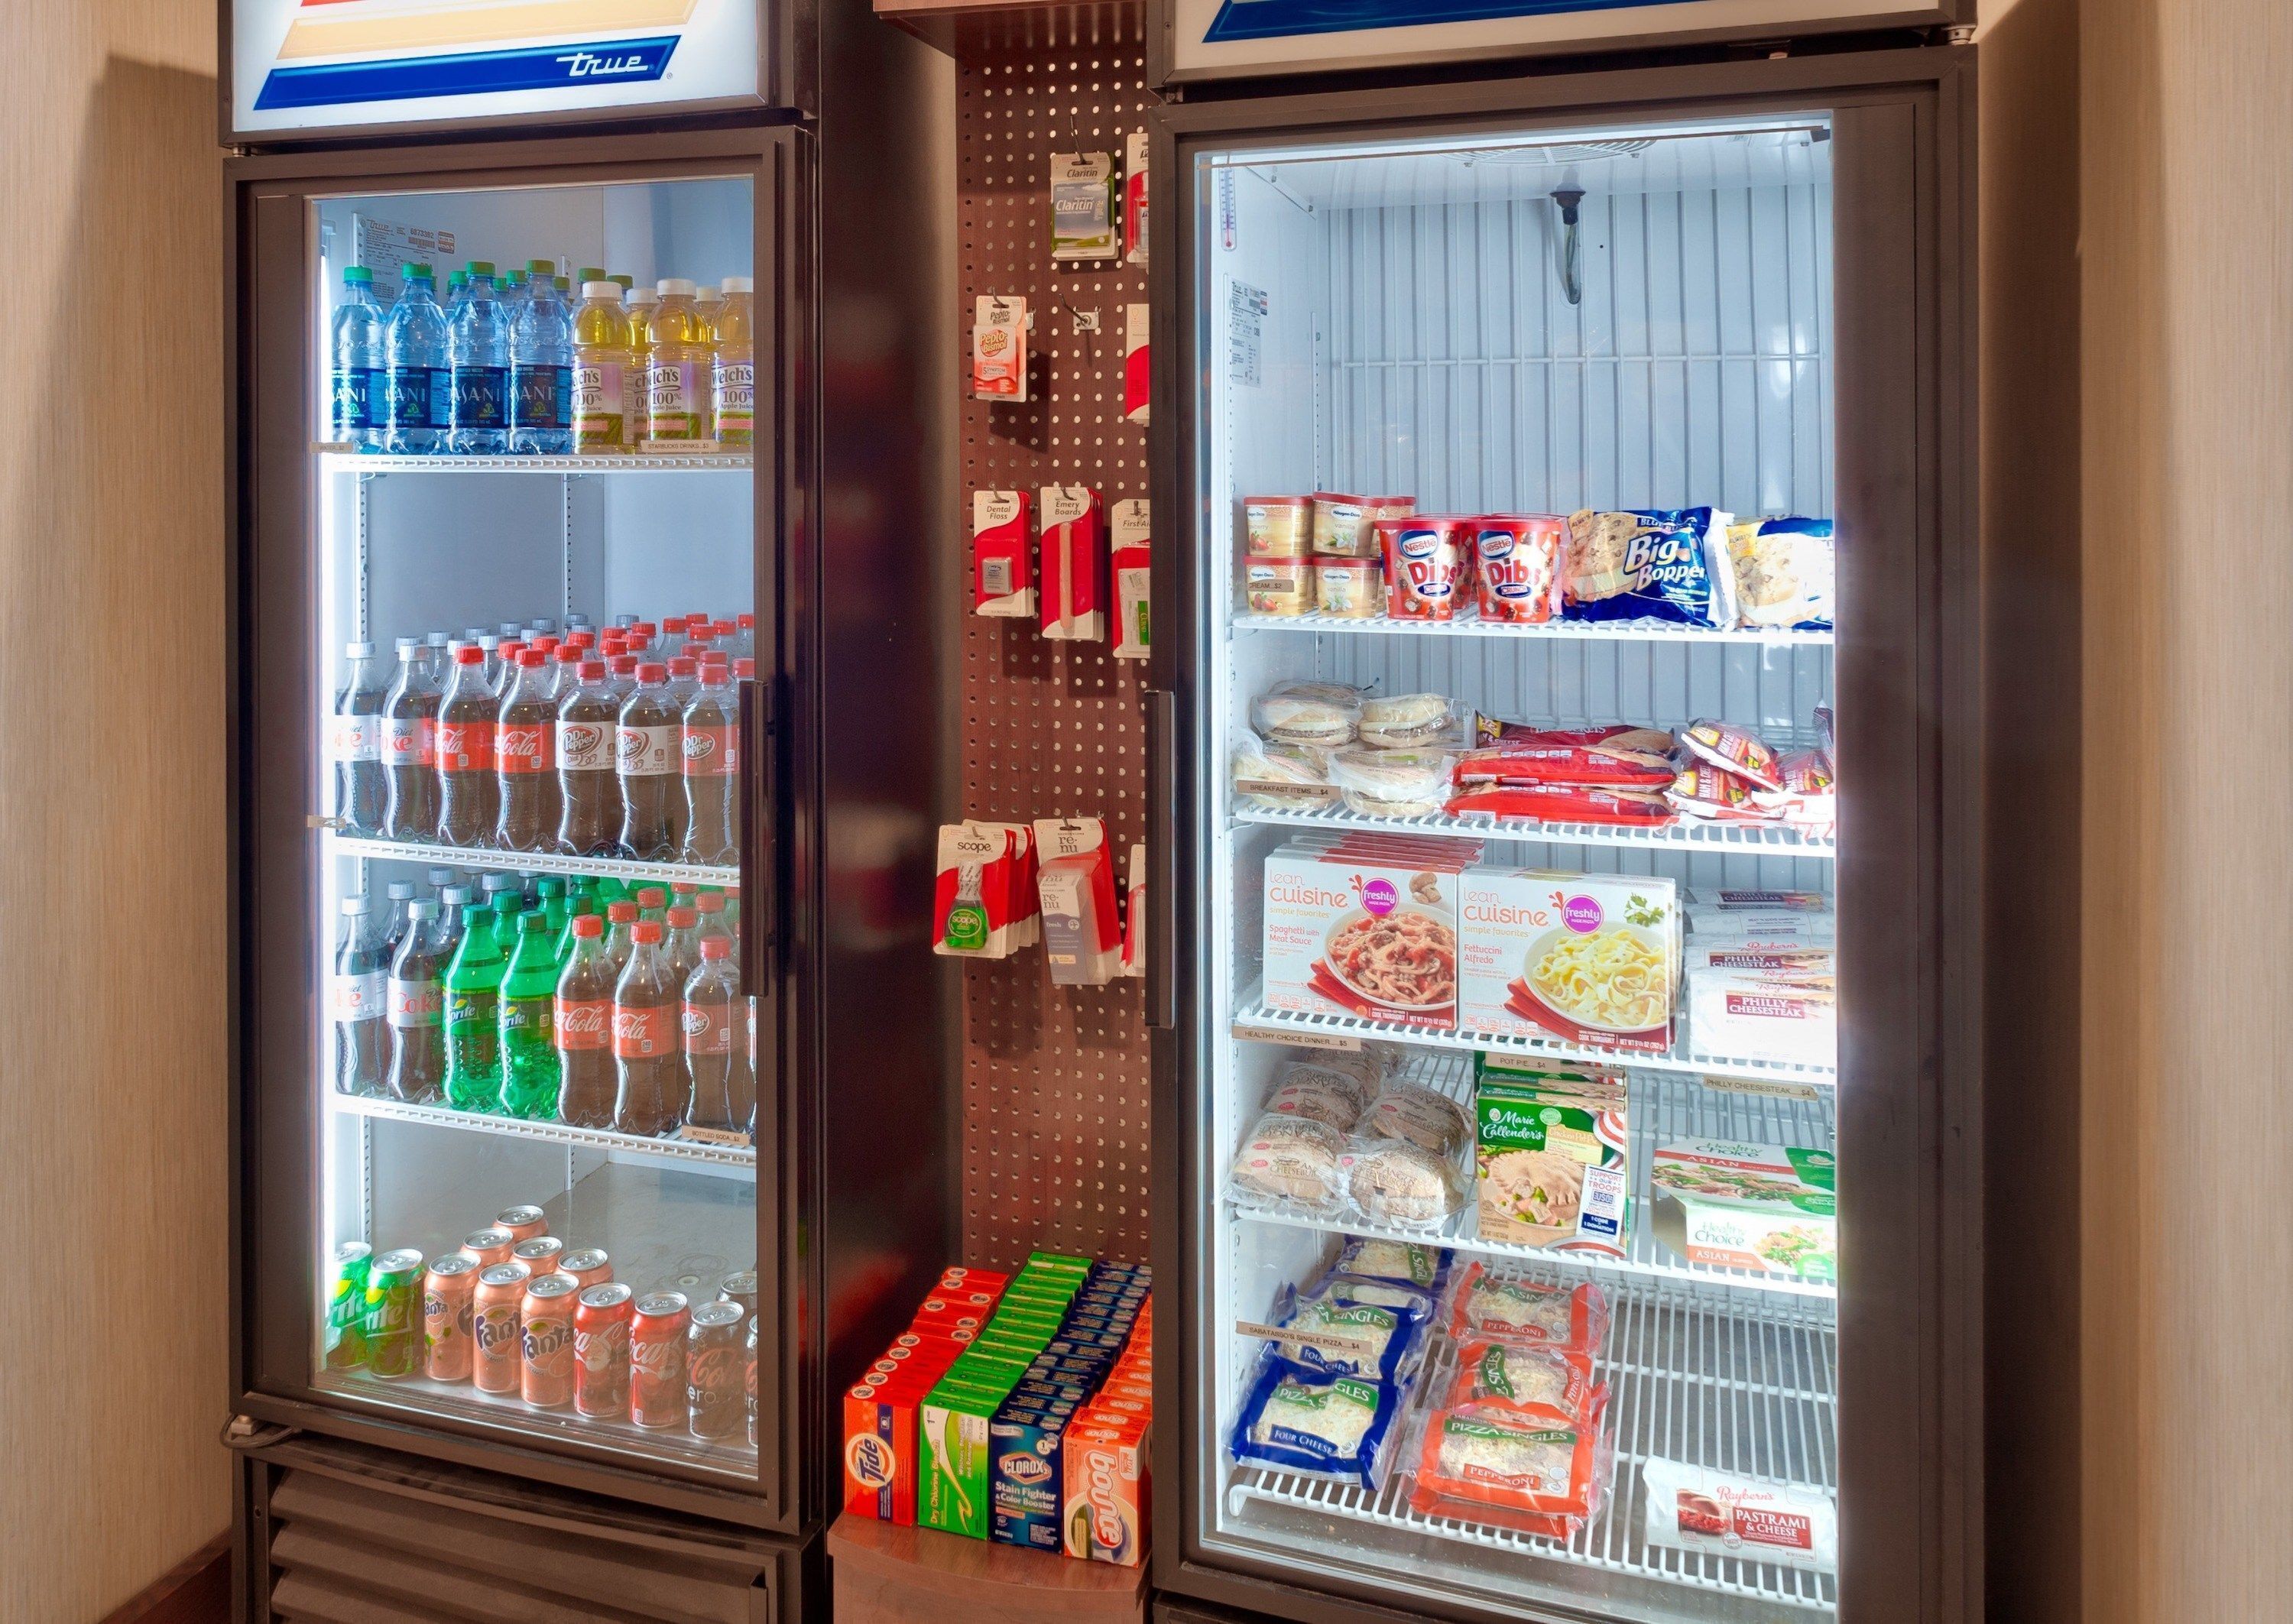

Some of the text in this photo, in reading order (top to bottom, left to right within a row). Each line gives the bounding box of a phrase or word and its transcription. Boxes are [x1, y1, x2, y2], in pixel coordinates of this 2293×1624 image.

[556, 51, 648, 76] true
[1066, 168, 1098, 179] Claritin
[1056, 199, 1094, 212] Claritin
[980, 332, 1008, 345] Pepto-
[982, 342, 1007, 353] Bismol
[654, 368, 679, 384] lch's
[712, 366, 753, 384] Welch's
[335, 388, 366, 402] ANI
[449, 383, 501, 405] ASANI
[653, 391, 683, 405] 100%
[1056, 501, 1079, 510] Emery
[1625, 535, 1680, 574] Big
[1486, 557, 1542, 587] Dibs
[563, 732, 596, 751] Pepper
[572, 730, 586, 741] Dr
[692, 734, 703, 746] Dr
[1250, 784, 1288, 793] BREAKFAST
[957, 841, 992, 854] scope
[1060, 844, 1078, 853] nu
[1270, 869, 1305, 886] lean
[1270, 886, 1348, 908] cuisine
[1362, 890, 1396, 904] freshly
[1463, 887, 1501, 904] lean
[952, 915, 978, 925] scope
[1269, 906, 1329, 919] simple favorites
[1463, 904, 1549, 928] cuisine
[1565, 906, 1600, 922] freshly
[1269, 925, 1305, 935] Spaghetti
[1464, 925, 1529, 938] simple favorites
[1269, 934, 1312, 945] Meat Sauce
[1464, 944, 1503, 955] Fettuccini
[1464, 955, 1494, 965] Alfredo
[1742, 997, 1789, 1008] PHILLY
[1729, 1006, 1802, 1018] CHEESESTEAK
[1244, 1030, 1275, 1040] HEALTHY
[1276, 1034, 1302, 1042] CHOICE
[1304, 1037, 1331, 1045] DINNER
[1706, 1078, 1734, 1089] PHILLY
[1734, 1082, 1791, 1094] CHEESESTEAK
[1496, 1110, 1535, 1129] Marie
[692, 1130, 715, 1139] BOTTLED
[1479, 1121, 1545, 1139] Callender's
[1695, 1146, 1760, 1158] Choice
[1687, 1156, 1740, 1168] ASIAN
[1589, 1169, 1622, 1182] SUPPORT
[1588, 1180, 1622, 1194] TROOPS
[1695, 1230, 1745, 1247] Choice
[1696, 1250, 1730, 1261] ASIAN
[425, 1301, 449, 1315] anta
[1249, 1327, 1295, 1339] SABATASSO'S
[1296, 1334, 1322, 1344] SINGLE
[1322, 1339, 1343, 1347] PIZZA
[1487, 1321, 1543, 1338] PEPPERONI
[688, 1386, 716, 1405] ero
[1279, 1387, 1315, 1408] PIZZA
[1451, 1422, 1568, 1441] PIZZA SINGLES
[1273, 1428, 1334, 1456] FOUR CHEESE
[858, 1438, 886, 1483] Tide
[1004, 1460, 1044, 1475] CLOROX
[1469, 1466, 1536, 1486] PEPPERONI
[995, 1481, 1057, 1502] Stain Fighter
[1089, 1451, 1122, 1544] bounce
[1001, 1493, 1022, 1505] Color
[1023, 1498, 1056, 1512] Booster
[1736, 1509, 1807, 1530] PASTRAMI
[1746, 1522, 1798, 1538] & CHEESE
